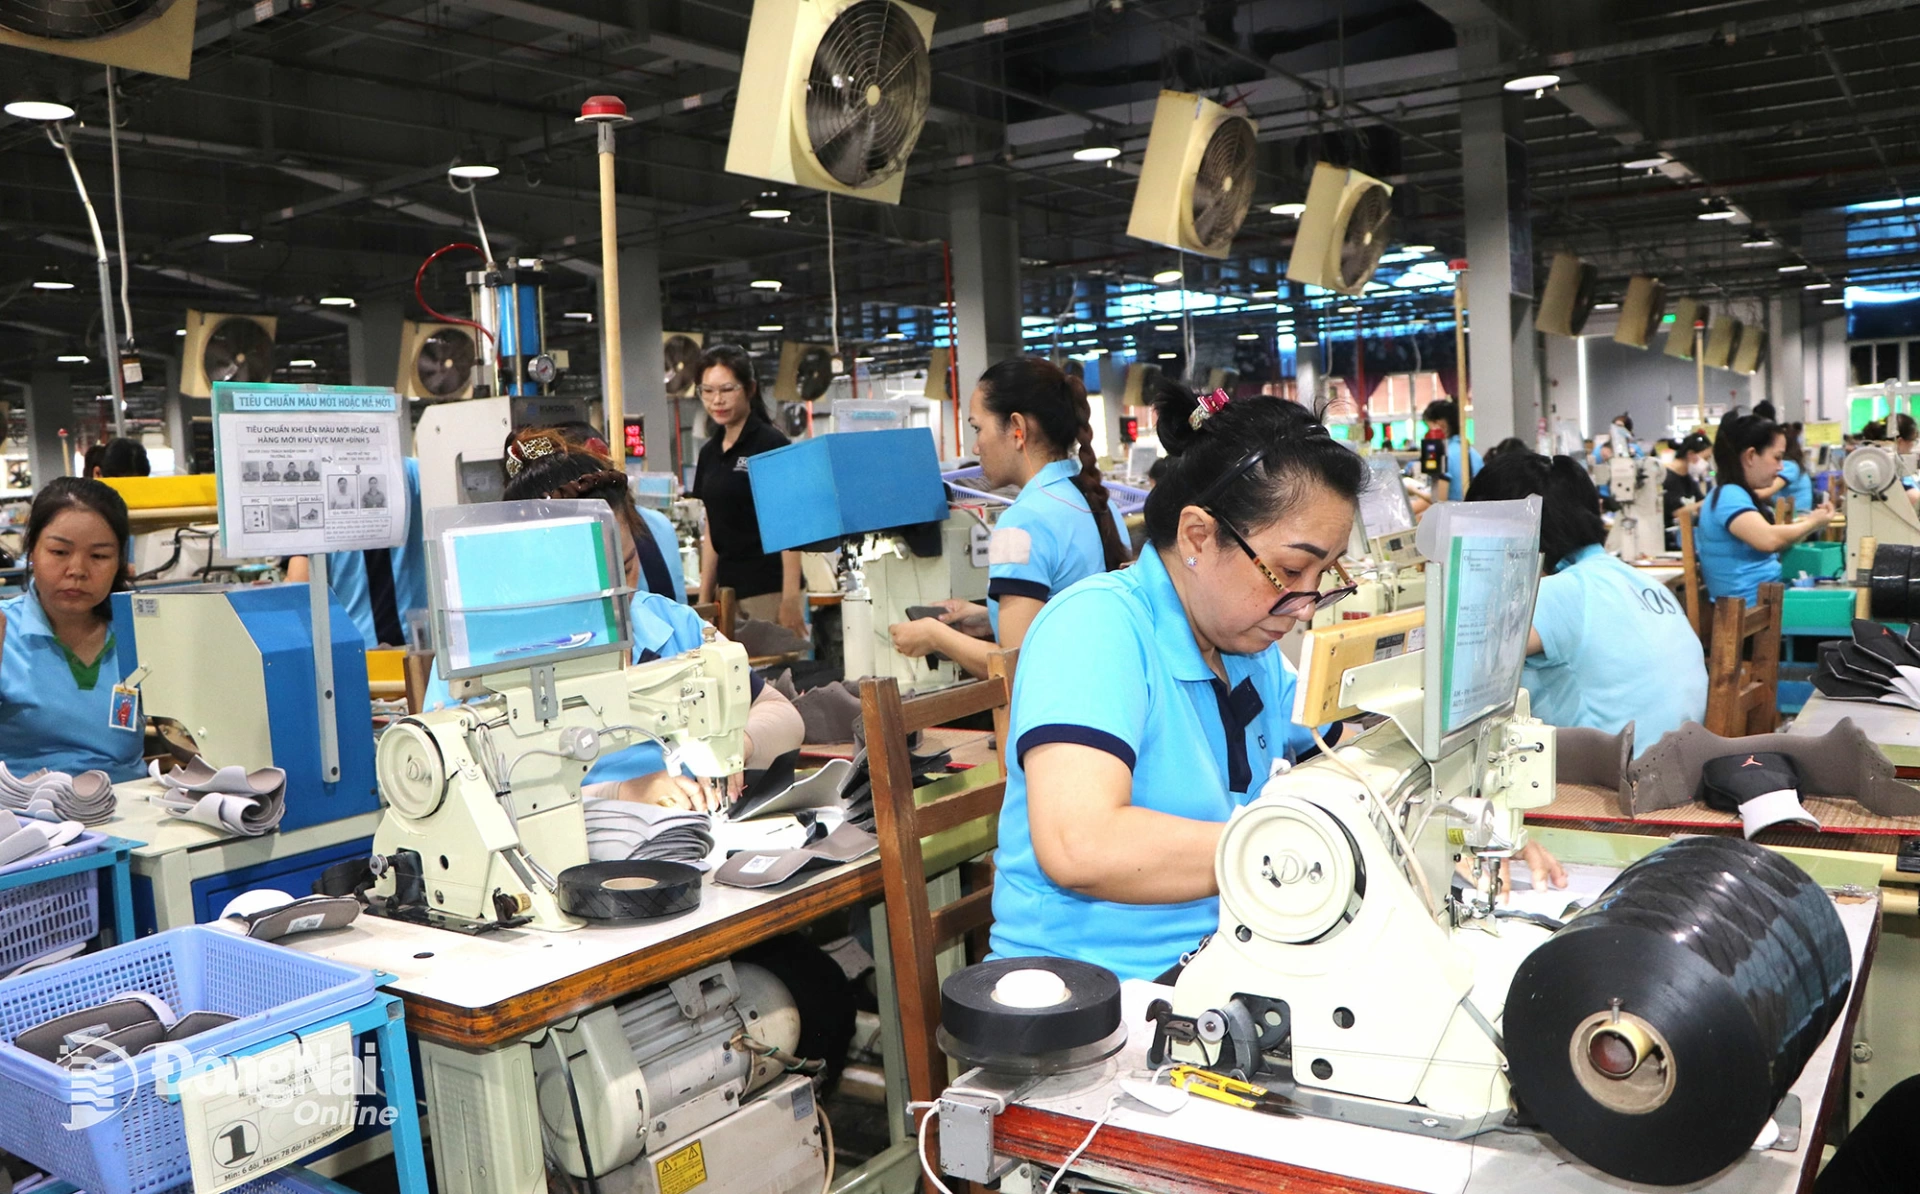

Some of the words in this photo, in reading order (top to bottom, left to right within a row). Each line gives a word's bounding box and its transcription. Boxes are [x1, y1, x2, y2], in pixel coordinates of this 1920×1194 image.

[239, 394, 261, 407] TIÊU
[298, 394, 318, 407] MÀU
[319, 395, 336, 407] MỚI
[246, 425, 263, 434] TIÊU
[318, 425, 335, 434] MÀU
[257, 434, 280, 444] HÀNG
[297, 436, 313, 444] KHU
[329, 436, 344, 444] MAY
[219, 1124, 256, 1166] 1
[224, 1170, 240, 1182] Min:
[241, 1167, 247, 1175] 6
